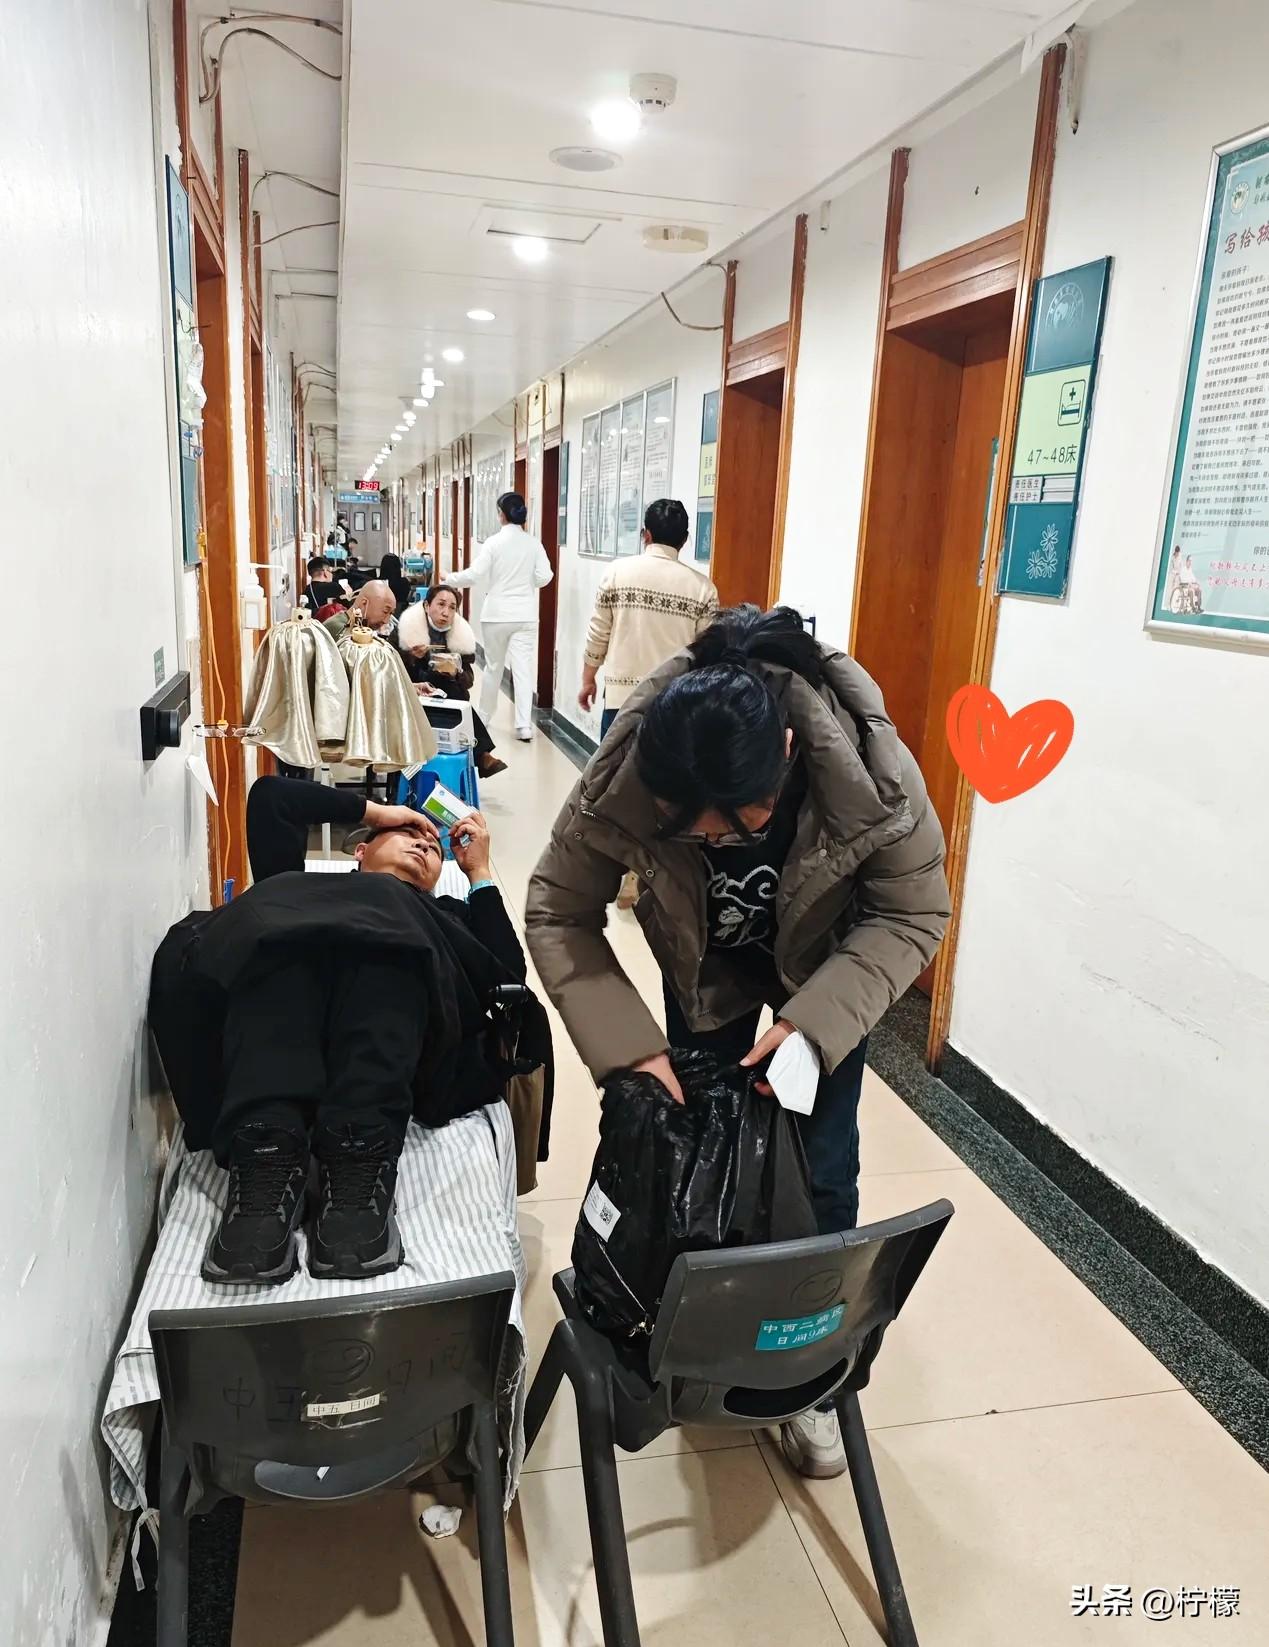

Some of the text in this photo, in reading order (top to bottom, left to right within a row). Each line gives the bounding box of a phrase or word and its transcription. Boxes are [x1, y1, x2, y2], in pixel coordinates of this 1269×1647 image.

[359, 482, 379, 490] 13:09
[1013, 492, 1038, 502] 责任护士
